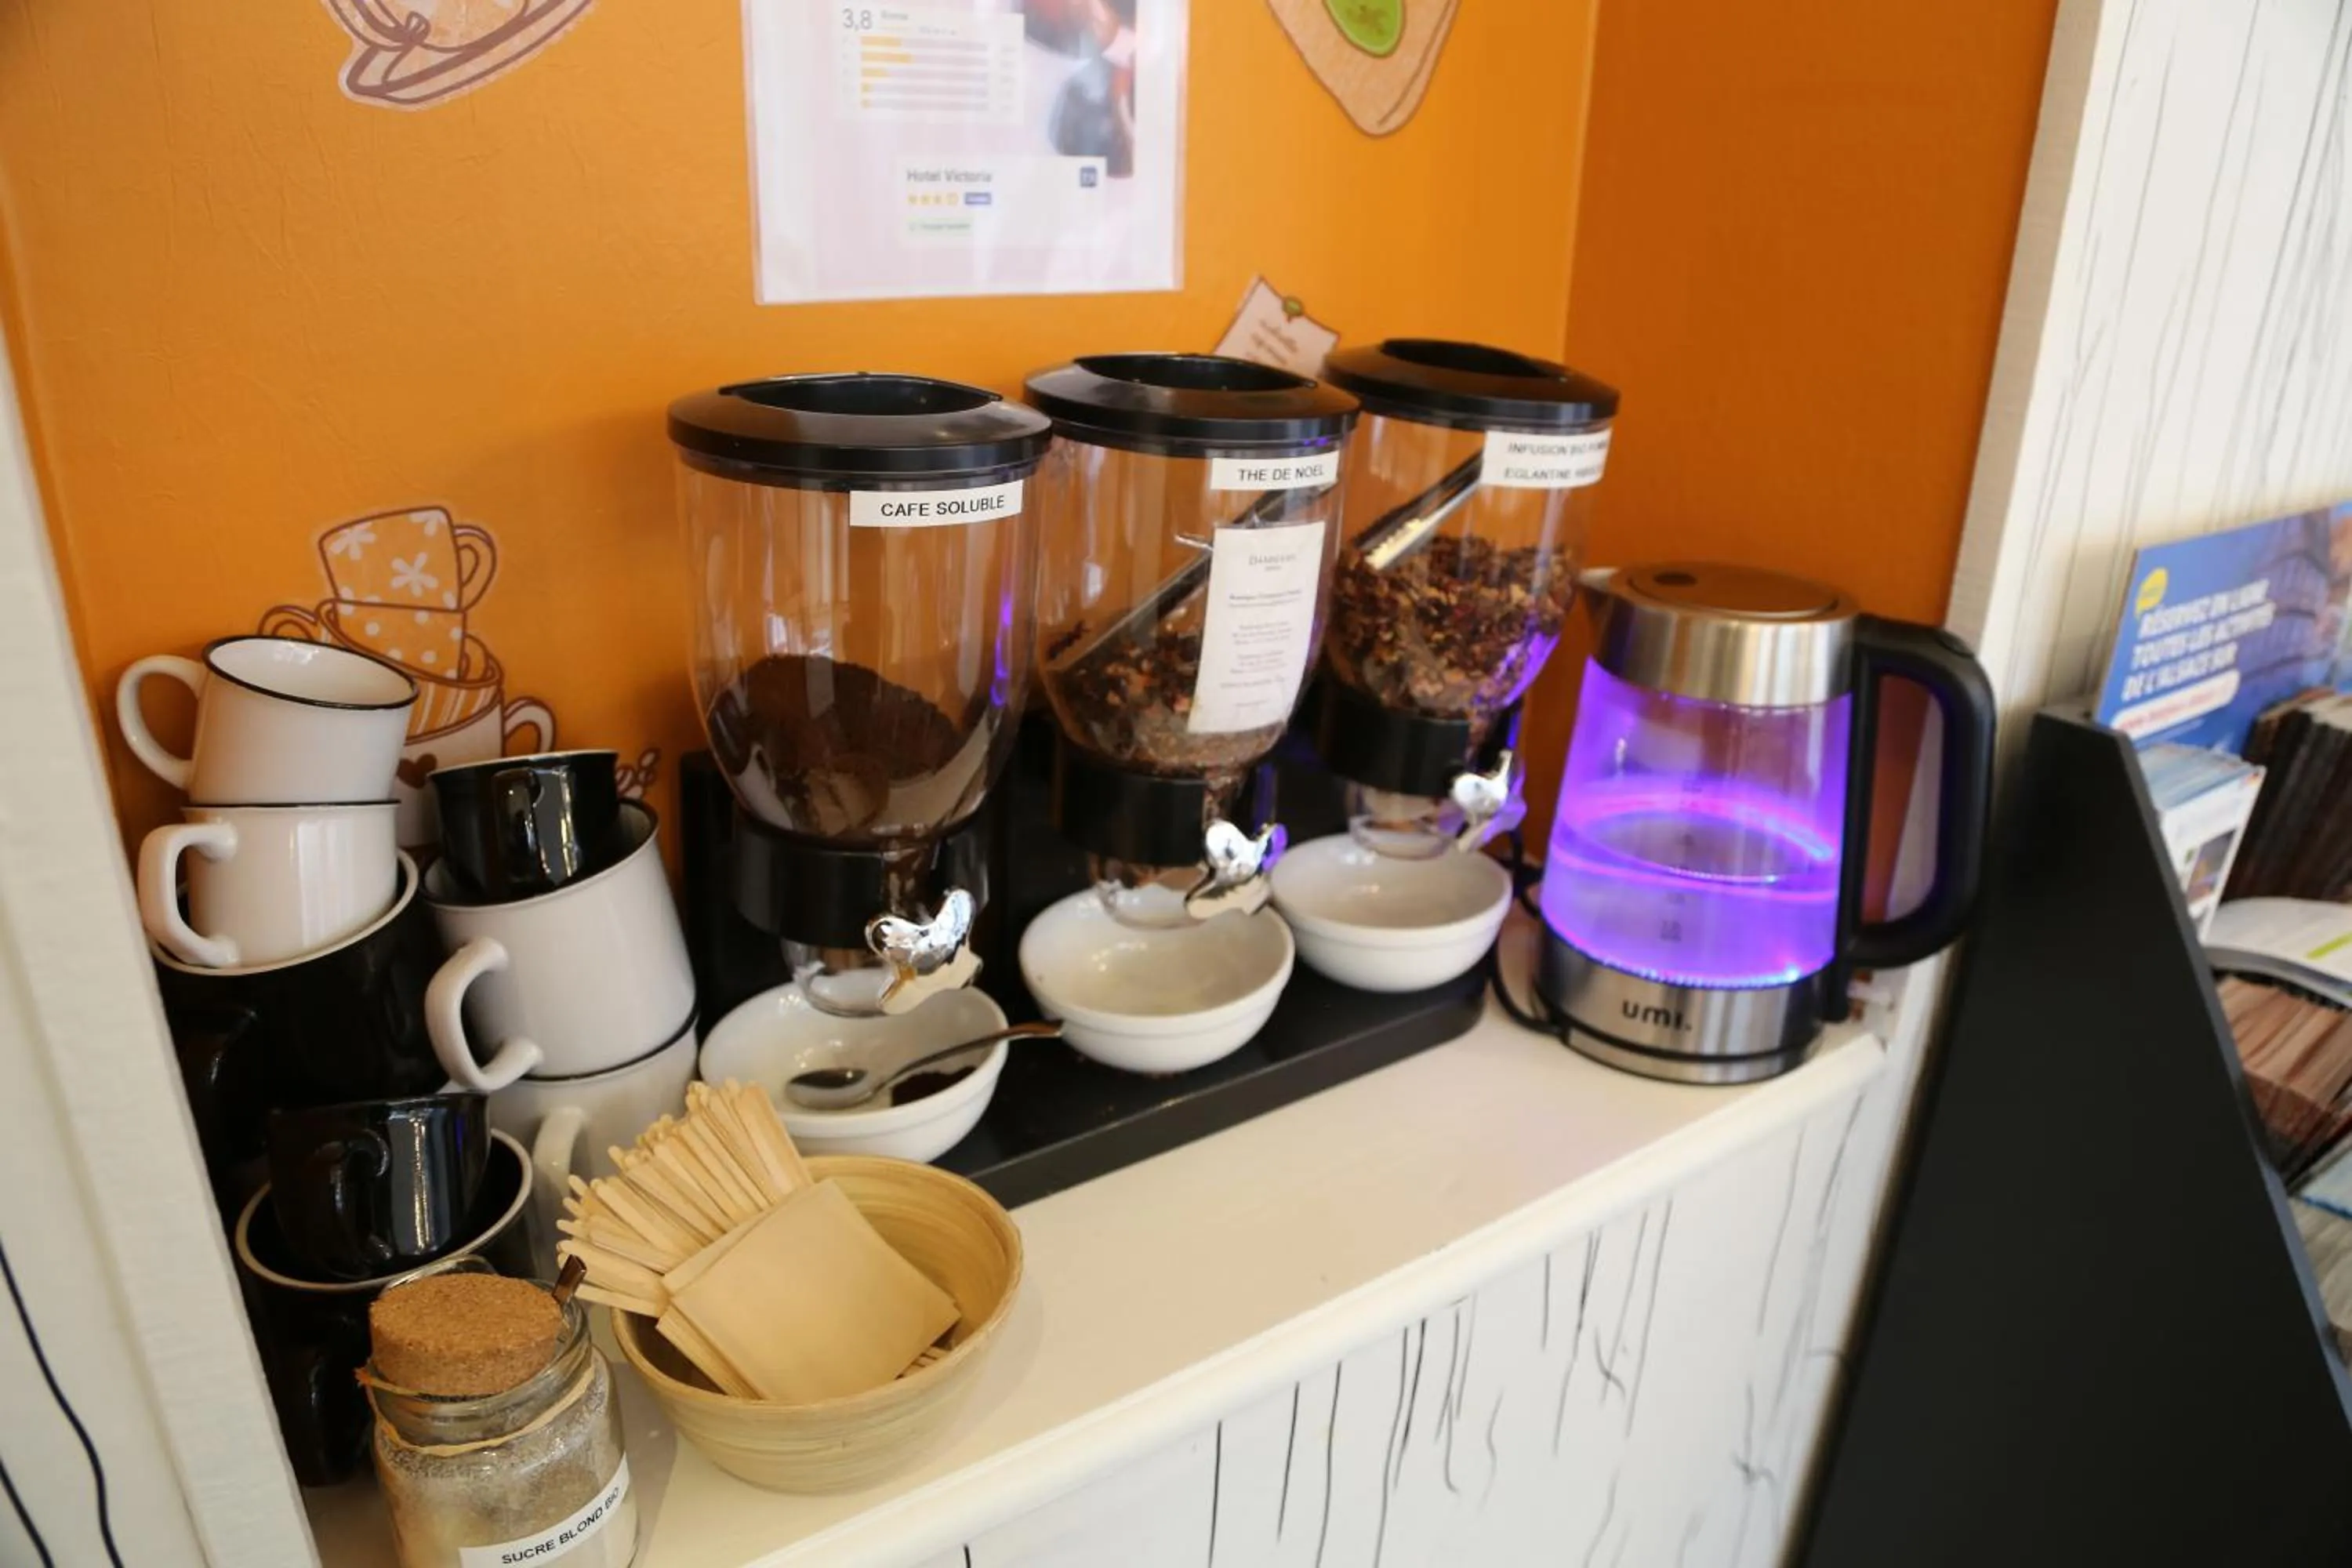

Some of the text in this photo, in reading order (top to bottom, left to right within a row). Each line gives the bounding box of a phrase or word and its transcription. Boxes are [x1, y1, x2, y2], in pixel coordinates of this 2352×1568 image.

[842, 8, 873, 31] 3,8
[944, 170, 992, 183] Victoria
[1508, 441, 1566, 456] INFUSION
[1238, 464, 1323, 481] THE DE NOEL
[880, 495, 1004, 517] CAFE SOLUBLE
[502, 1486, 619, 1564] SUCRE BLOND BIO
